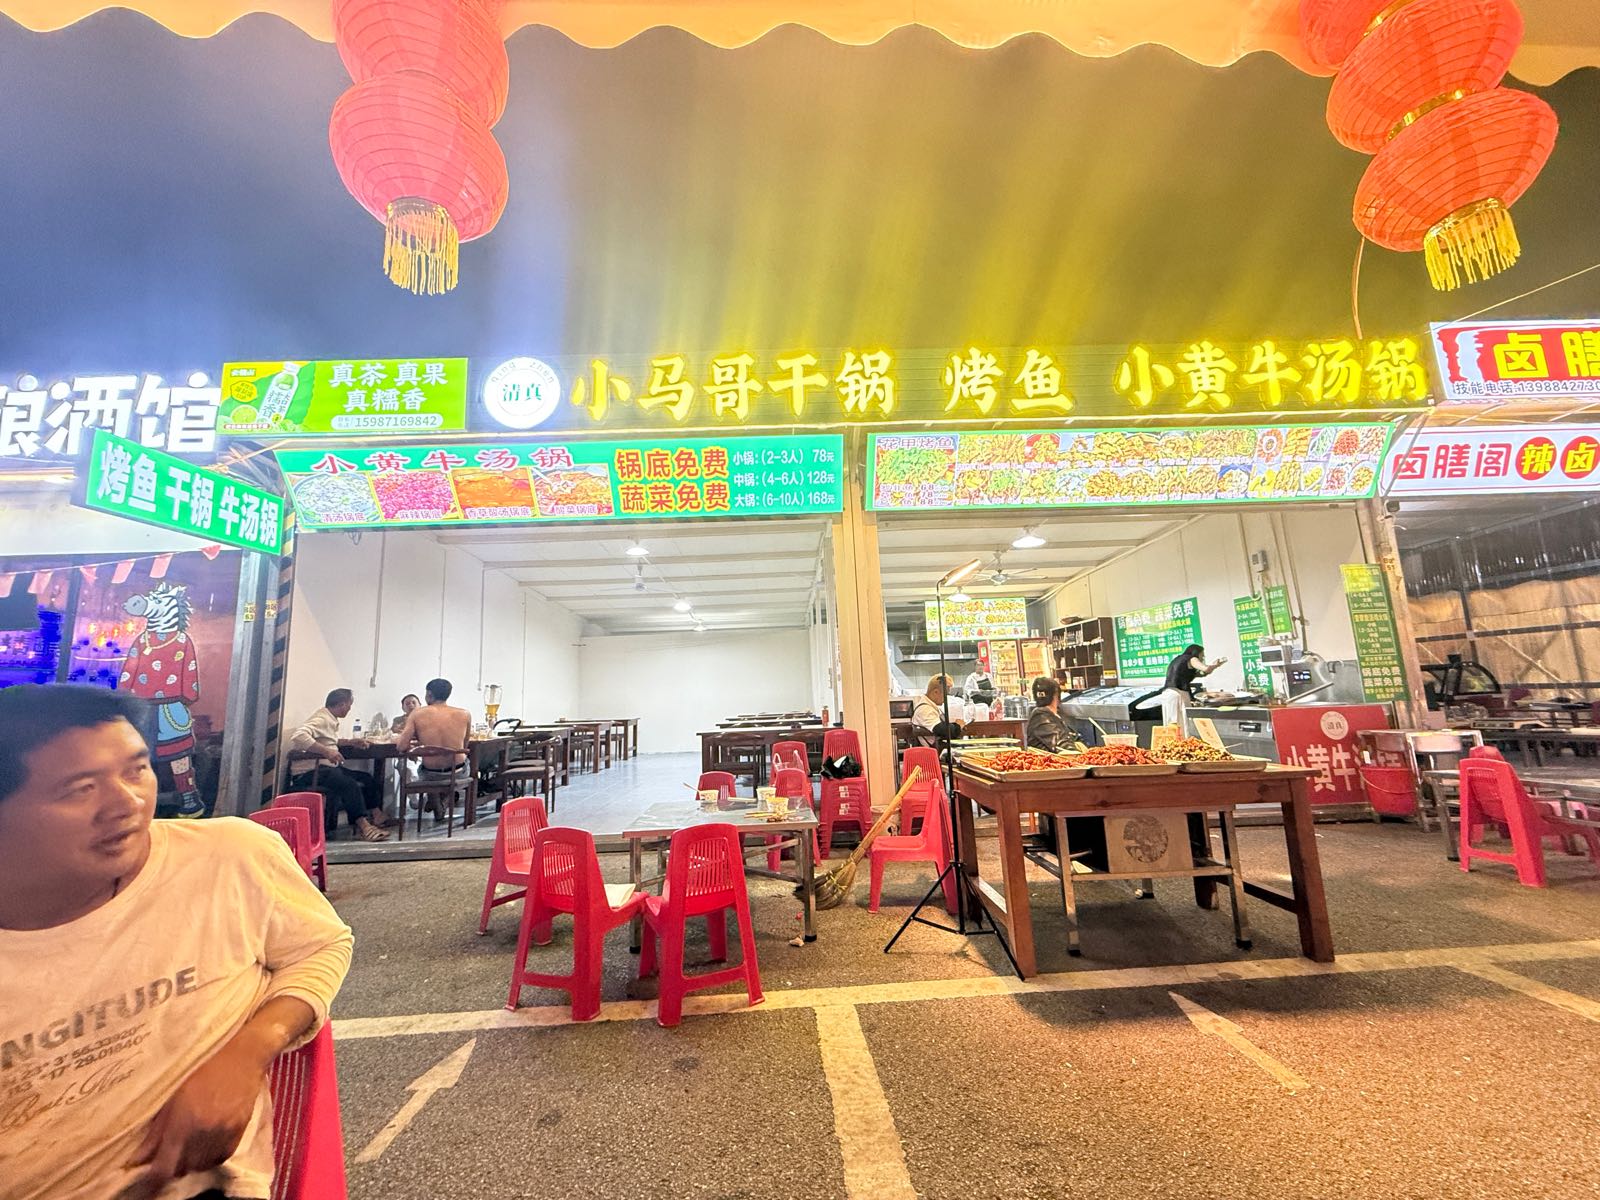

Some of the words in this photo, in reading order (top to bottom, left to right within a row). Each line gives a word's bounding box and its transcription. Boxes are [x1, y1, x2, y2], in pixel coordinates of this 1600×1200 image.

[329, 363, 388, 387] 真茶
[393, 362, 449, 386] 真果
[572, 350, 895, 419] 小马哥干锅
[944, 347, 1073, 414] 烤鱼
[1117, 338, 1428, 409] 小黄牛汤锅
[343, 388, 427, 412] 真糯香
[355, 416, 437, 427] 15987169842
[312, 449, 573, 474] 小黄牛汤锅
[617, 449, 727, 478] 锅底免费
[1392, 443, 1512, 479] 卤膳阁
[97, 441, 158, 512] 烤鱼
[165, 466, 214, 529] 干锅
[217, 486, 279, 547] 牛汤锅
[620, 483, 729, 512] 蔬菜免费
